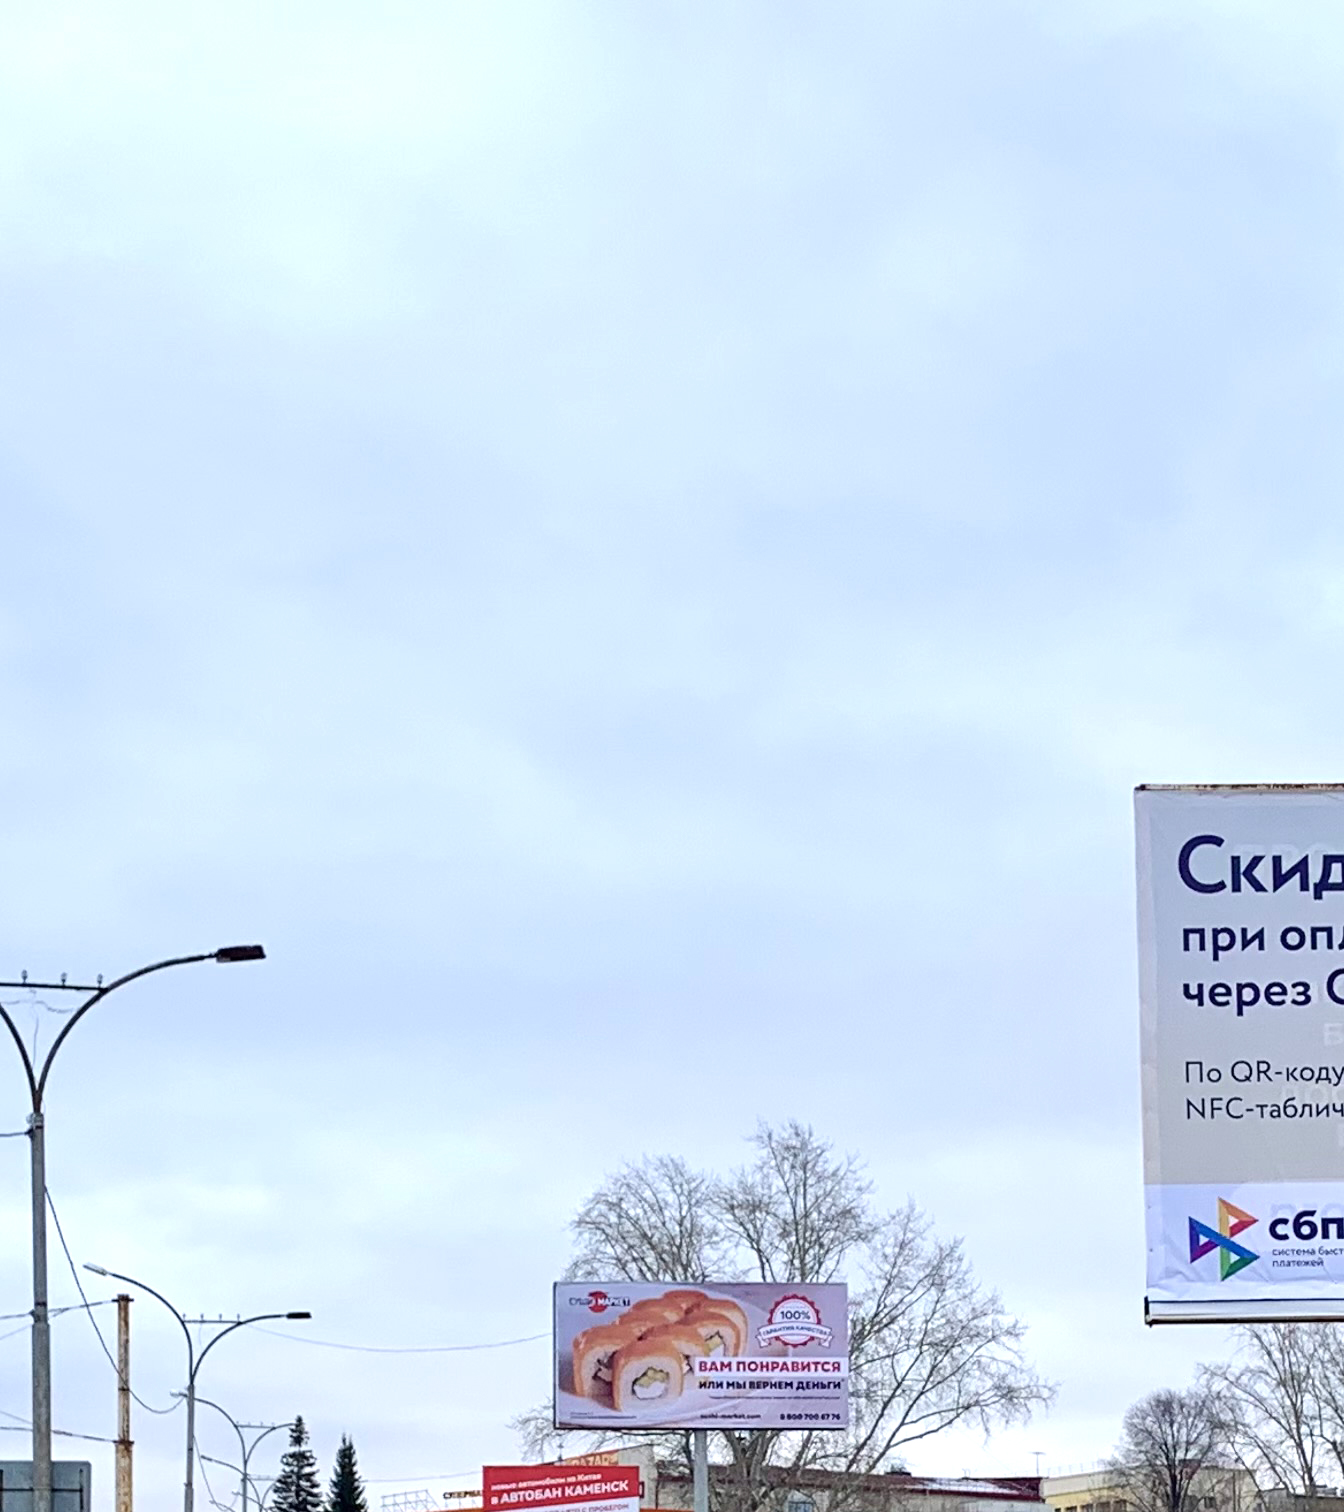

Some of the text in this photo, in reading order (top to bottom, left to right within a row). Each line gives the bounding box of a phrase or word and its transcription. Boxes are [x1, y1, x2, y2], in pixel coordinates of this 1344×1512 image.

[1182, 924, 1265, 962] при
[1182, 981, 1312, 1016] через
[1184, 1062, 1222, 1084] По
[1272, 1248, 1316, 1256] система
[1272, 1257, 1324, 1268] платежей
[780, 1310, 811, 1320] 100%
[698, 1361, 841, 1372] ВАМ ПОНРАВИТСЯ
[698, 1381, 724, 1390] ИЛИ
[726, 1381, 746, 1390] МЫ
[749, 1380, 793, 1390] ВЕРНЕМ
[500, 1487, 562, 1504] АВТОБАН
[564, 1480, 629, 1497] КАМЕНСК
